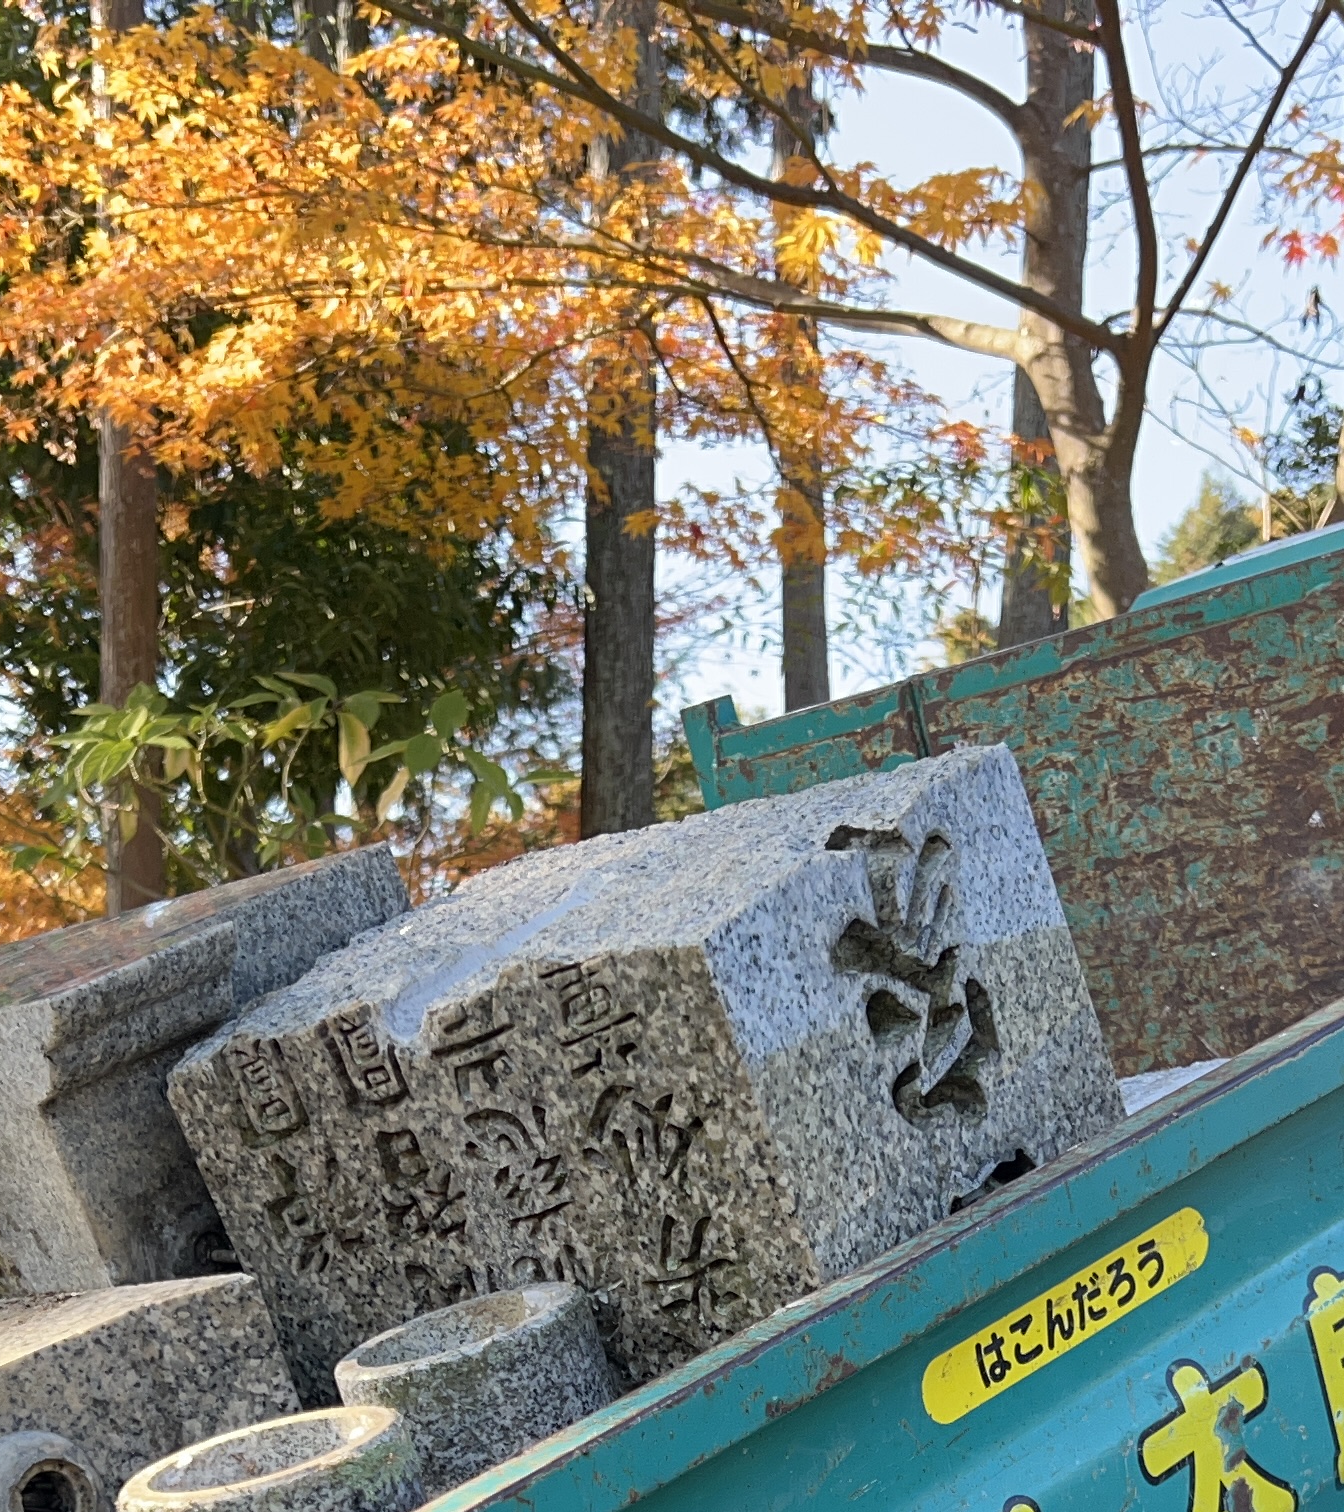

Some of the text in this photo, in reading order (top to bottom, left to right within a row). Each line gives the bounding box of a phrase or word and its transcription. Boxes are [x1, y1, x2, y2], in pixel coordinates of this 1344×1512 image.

[975, 1239, 1165, 1390] はこんだろう
